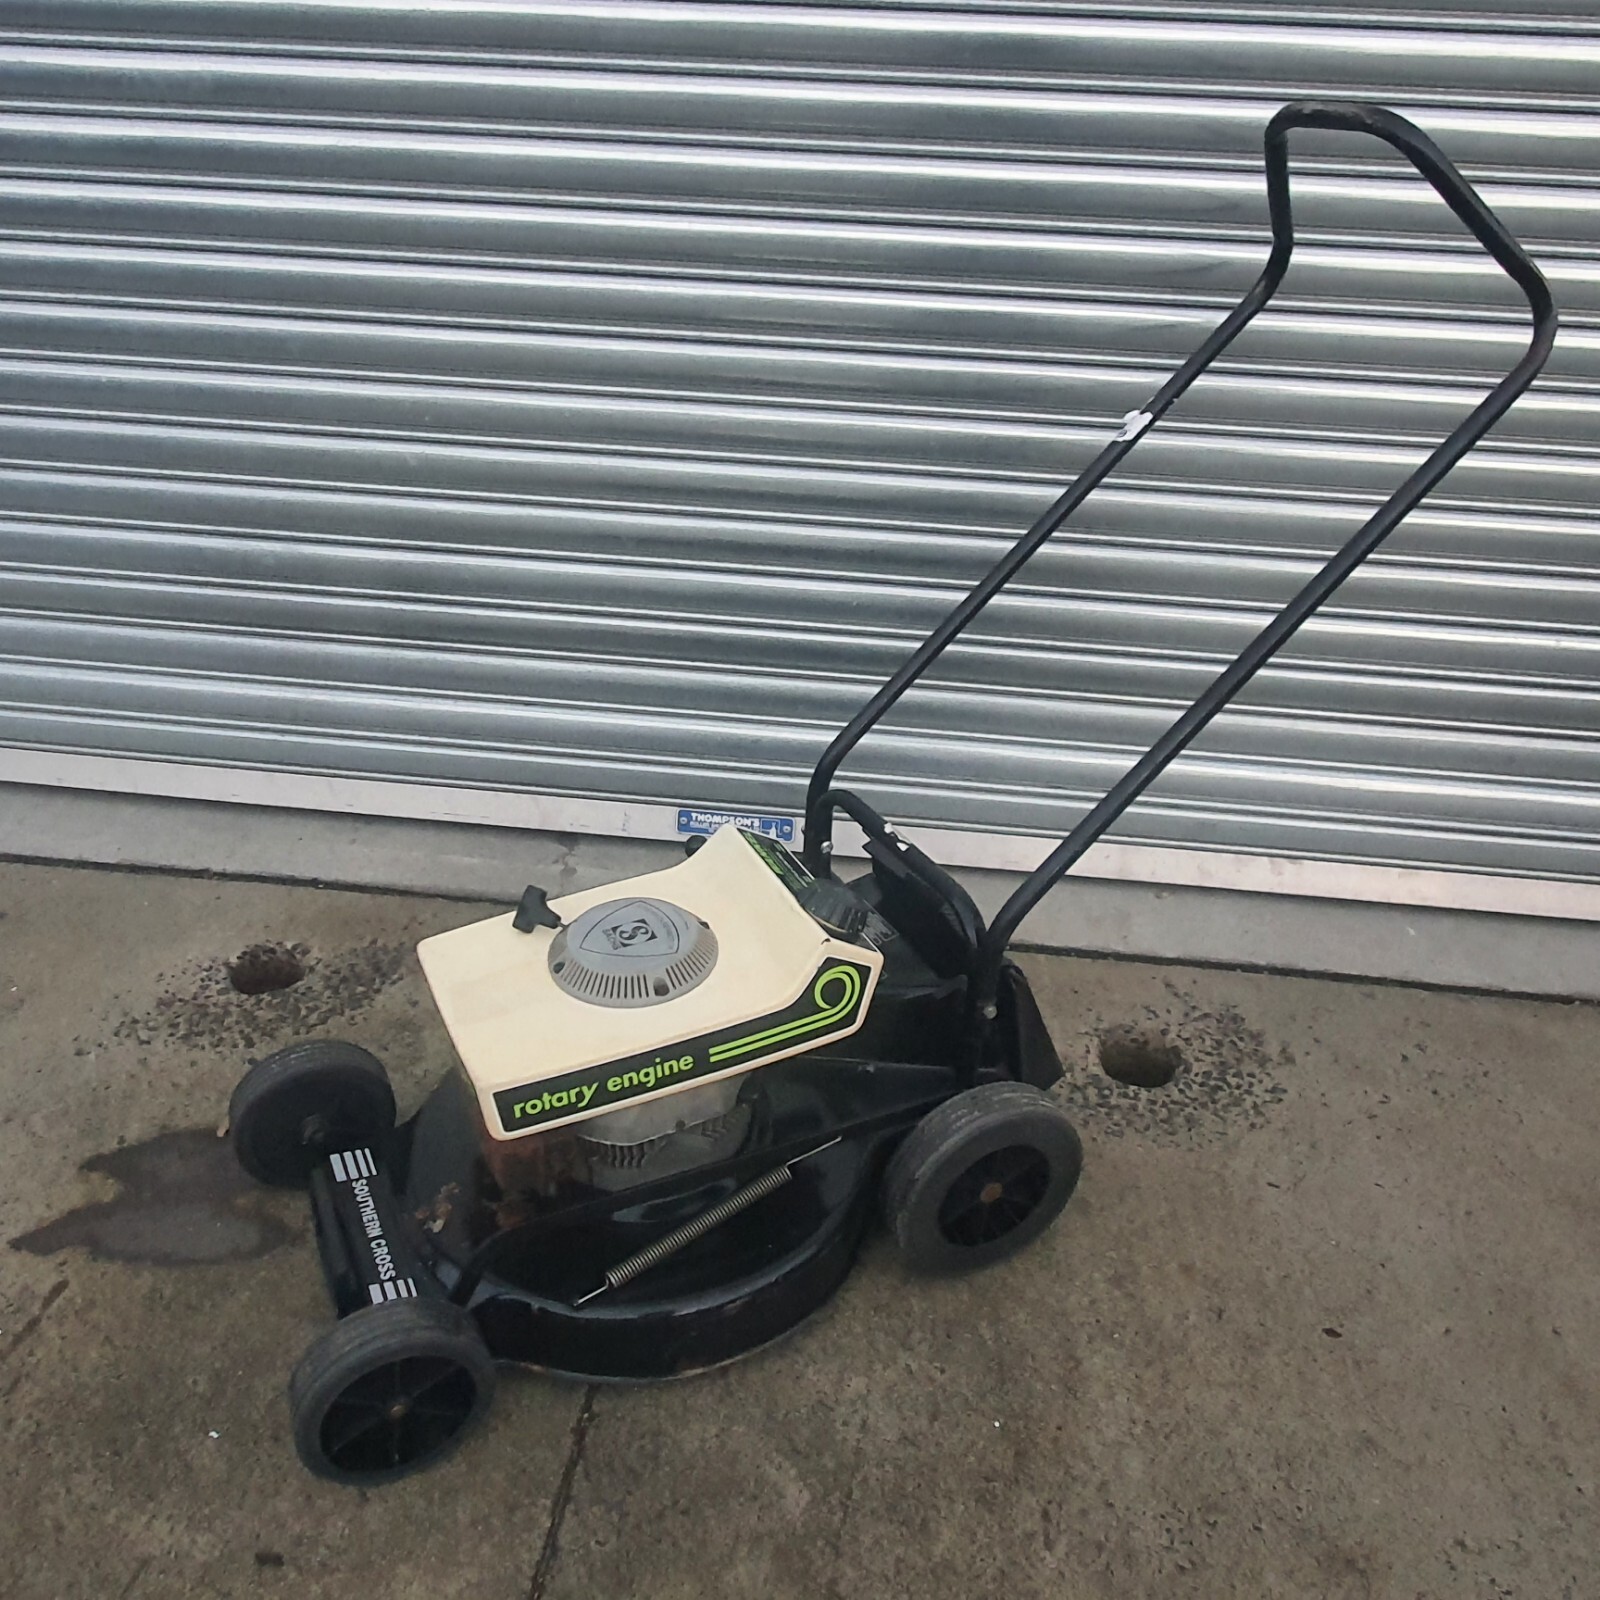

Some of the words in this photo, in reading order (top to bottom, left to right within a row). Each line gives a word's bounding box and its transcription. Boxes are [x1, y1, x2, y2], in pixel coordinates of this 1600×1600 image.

[690, 812, 760, 827] THOMPSON'S
[513, 1082, 599, 1119] rotary
[606, 1055, 694, 1092] engine
[352, 1179, 384, 1238] SOUTHERN
[370, 1239, 396, 1280] CROSS
